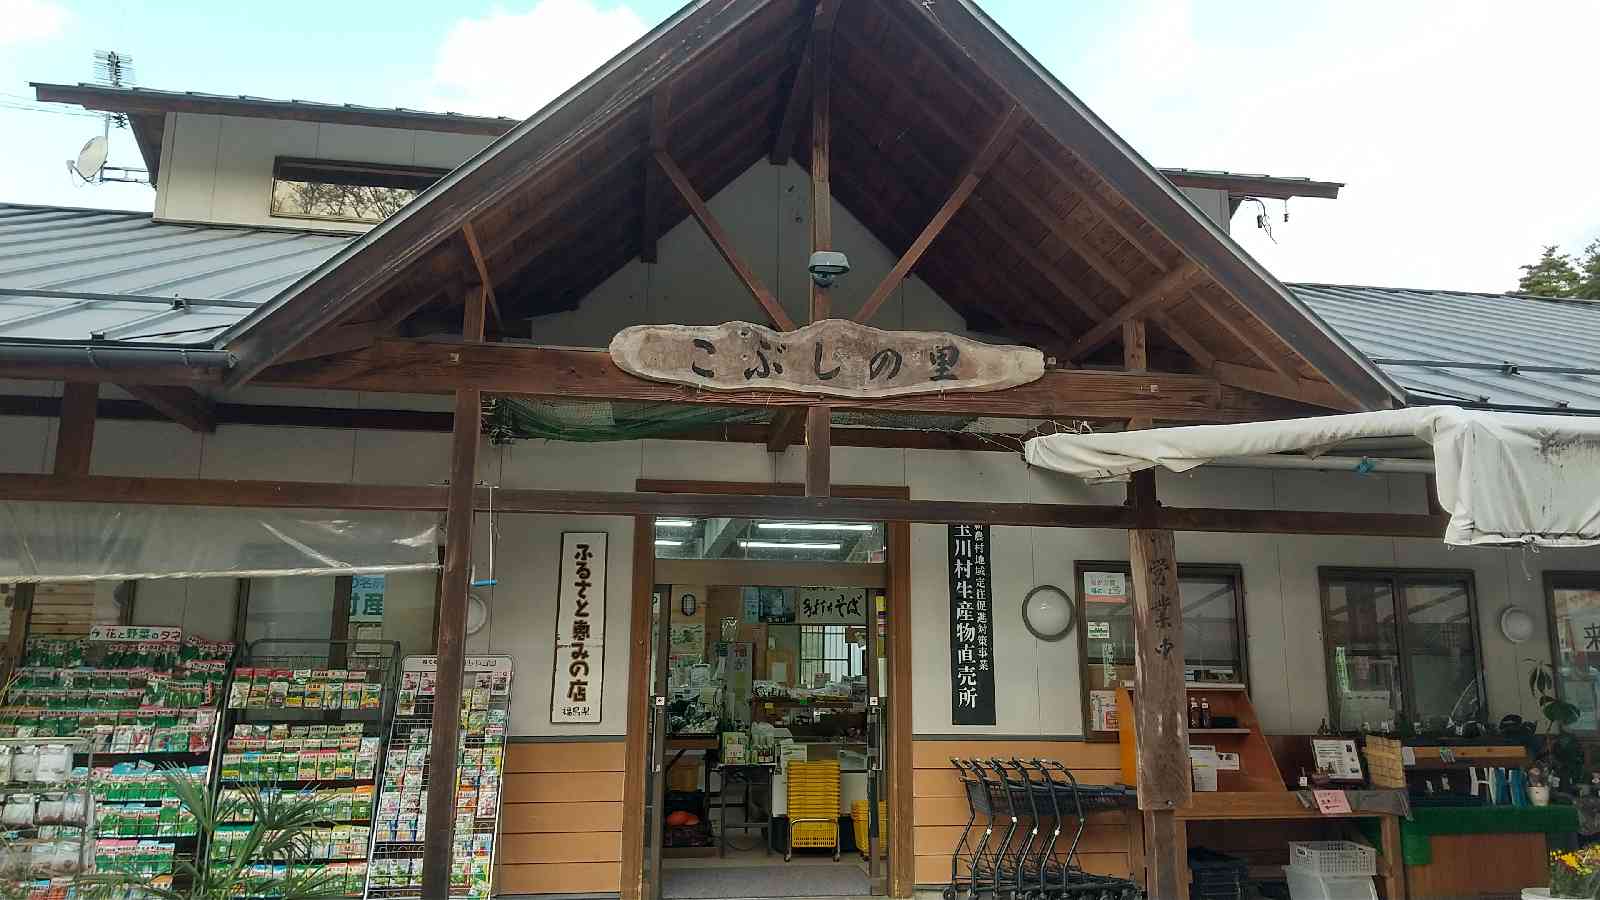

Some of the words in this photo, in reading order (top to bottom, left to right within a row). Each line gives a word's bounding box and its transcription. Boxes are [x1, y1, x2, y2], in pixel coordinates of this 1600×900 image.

[690, 337, 961, 381] こぶしの里
[953, 523, 978, 709] 玉川村生産物直売所
